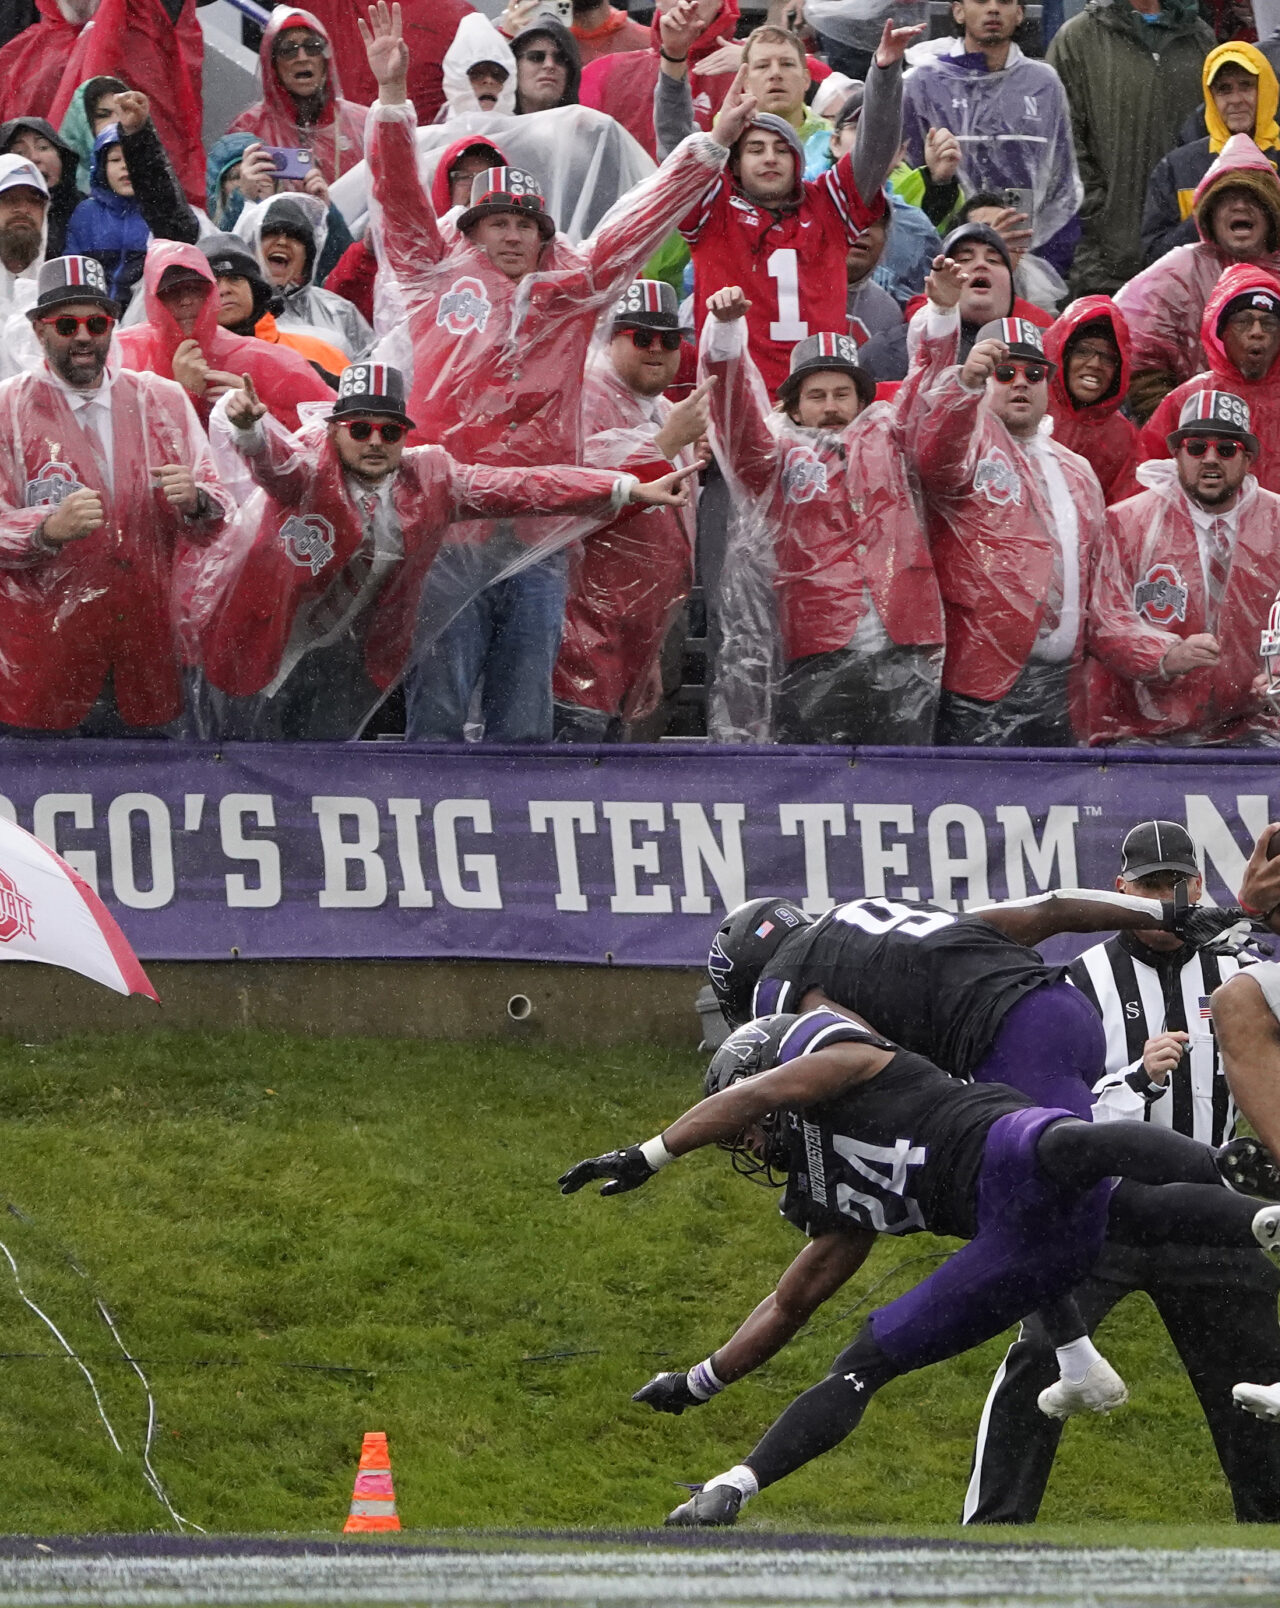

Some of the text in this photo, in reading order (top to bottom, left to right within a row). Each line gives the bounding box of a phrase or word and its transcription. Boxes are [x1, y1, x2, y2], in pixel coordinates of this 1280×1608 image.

[767, 249, 808, 341] 1
[0, 792, 282, 910] GO'S
[312, 796, 503, 910] BIG
[528, 800, 746, 914] TEN
[780, 802, 1079, 913] TEAM
[774, 907, 799, 927] 9
[833, 1133, 927, 1232] 24
